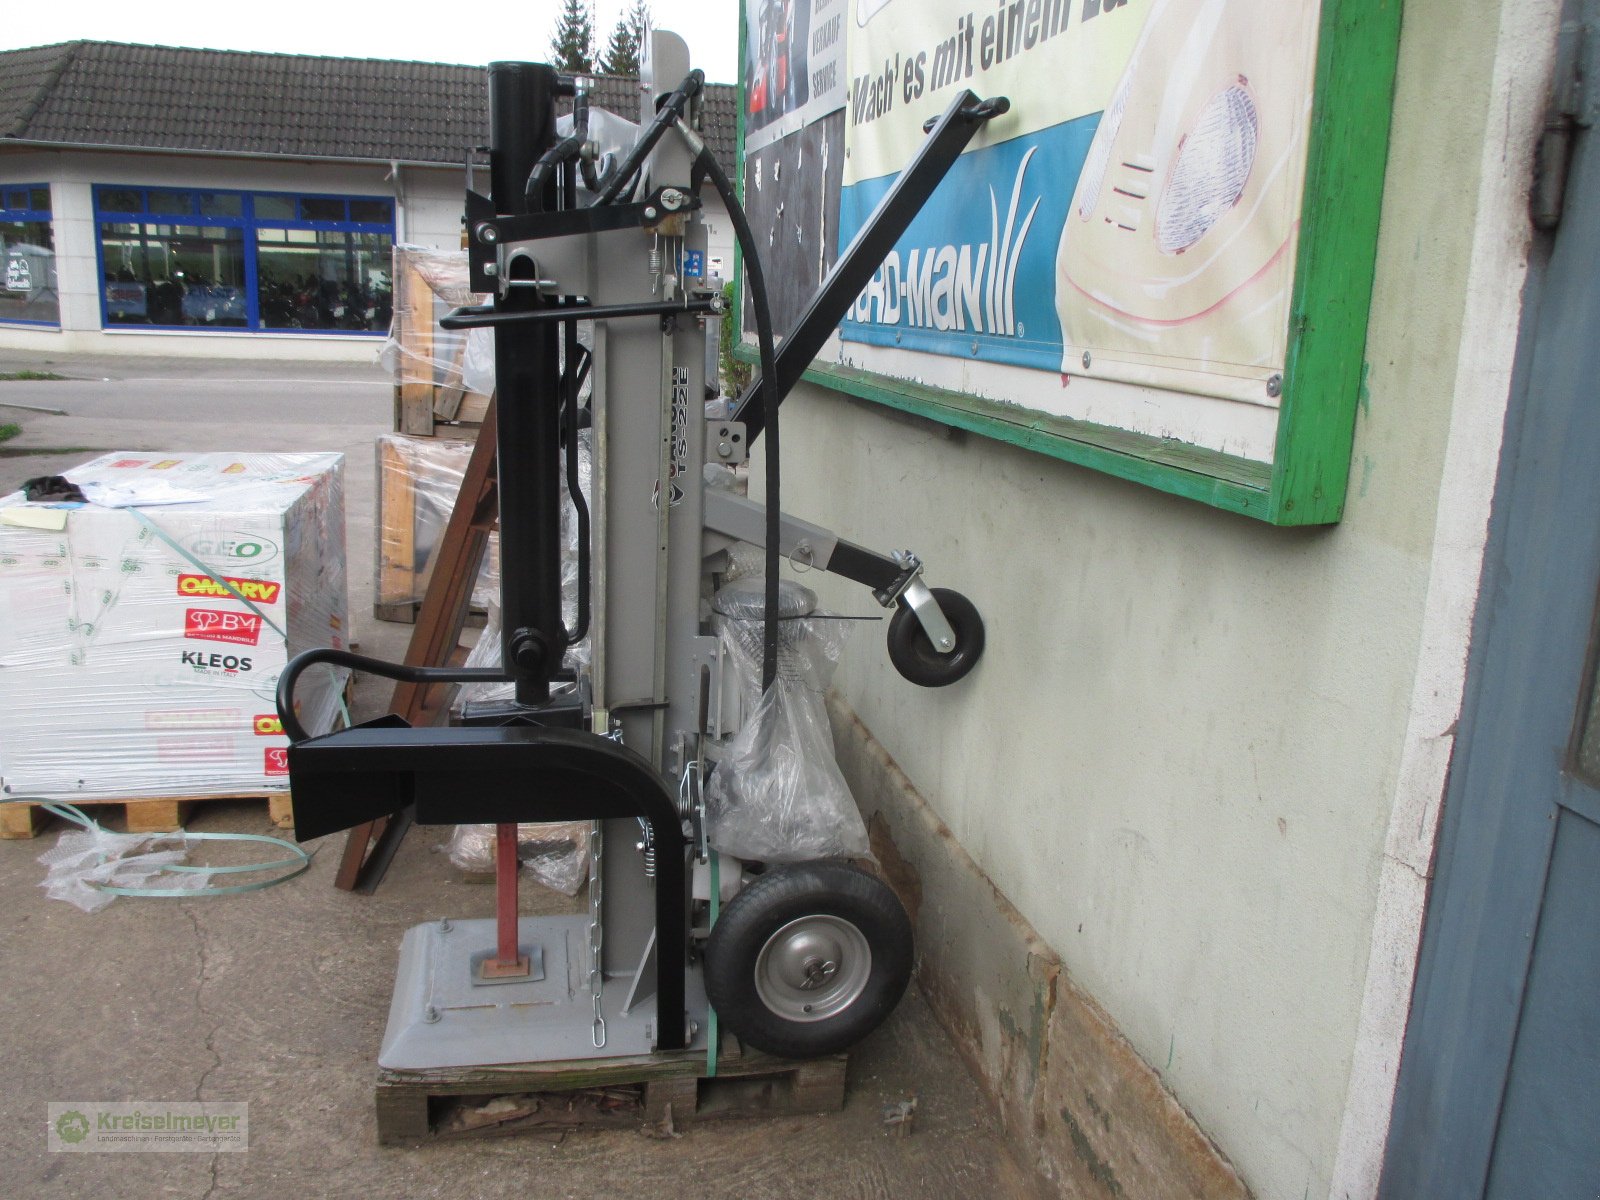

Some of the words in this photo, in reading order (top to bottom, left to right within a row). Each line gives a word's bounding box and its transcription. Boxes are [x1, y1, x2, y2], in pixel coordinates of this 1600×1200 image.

[812, 13, 841, 57] VERKAUF
[812, 60, 837, 99] SERVICE
[852, 52, 900, 128] Mach'
[903, 51, 927, 104] es
[931, 12, 974, 92] mit
[980, 0, 1071, 71] einem
[677, 366, 688, 478] TS-22E
[222, 614, 256, 633] BM
[182, 651, 253, 671] KLEOS
